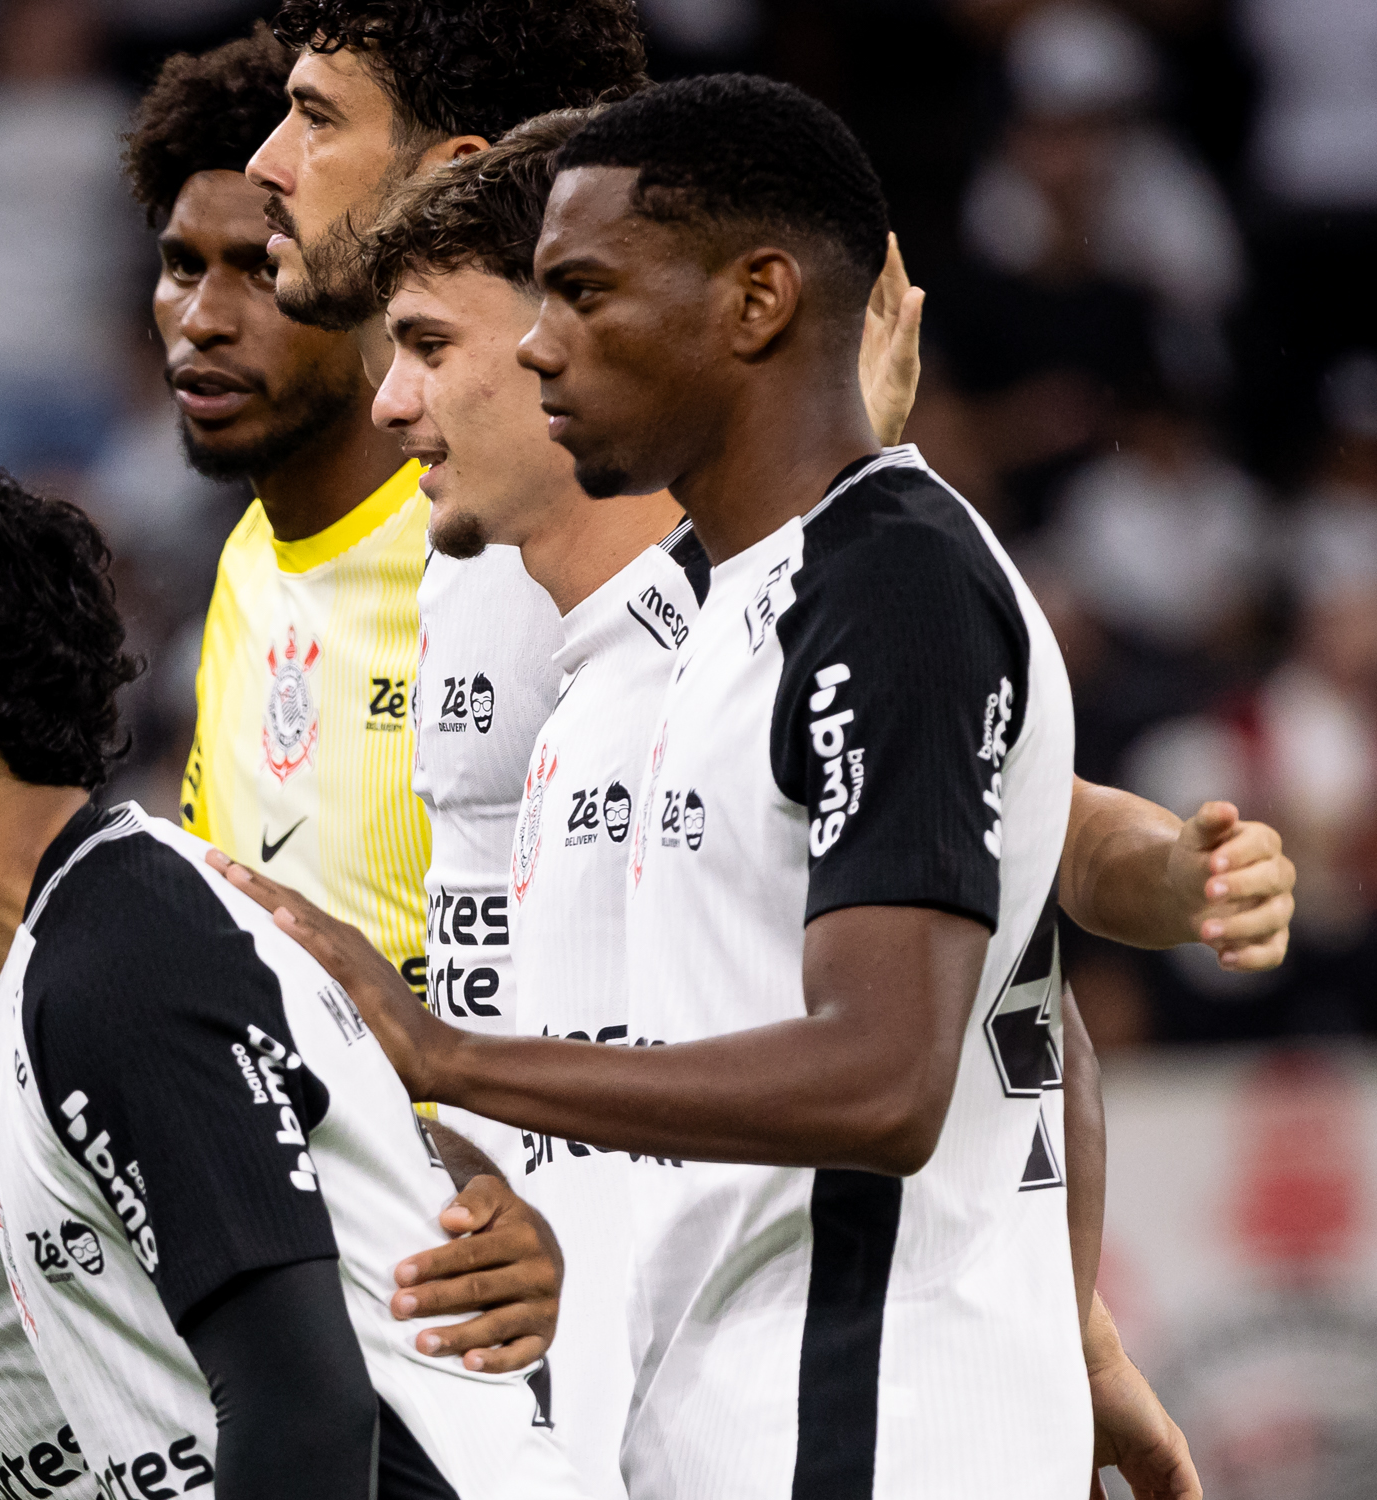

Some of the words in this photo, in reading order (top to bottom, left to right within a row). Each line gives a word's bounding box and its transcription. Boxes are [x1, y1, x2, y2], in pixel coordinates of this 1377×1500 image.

[638, 584, 689, 650] mesa
[370, 678, 406, 718] Zé
[441, 676, 468, 718] Zé
[438, 722, 468, 732] DELIVERY
[810, 709, 854, 857] bmg
[847, 748, 865, 815] banco
[567, 787, 600, 833] Zé
[662, 789, 681, 833] Zé
[565, 833, 598, 847] DELIVERY
[231, 1043, 269, 1104] banco
[85, 1129, 159, 1273] bmg
[26, 1229, 68, 1271] Zé
